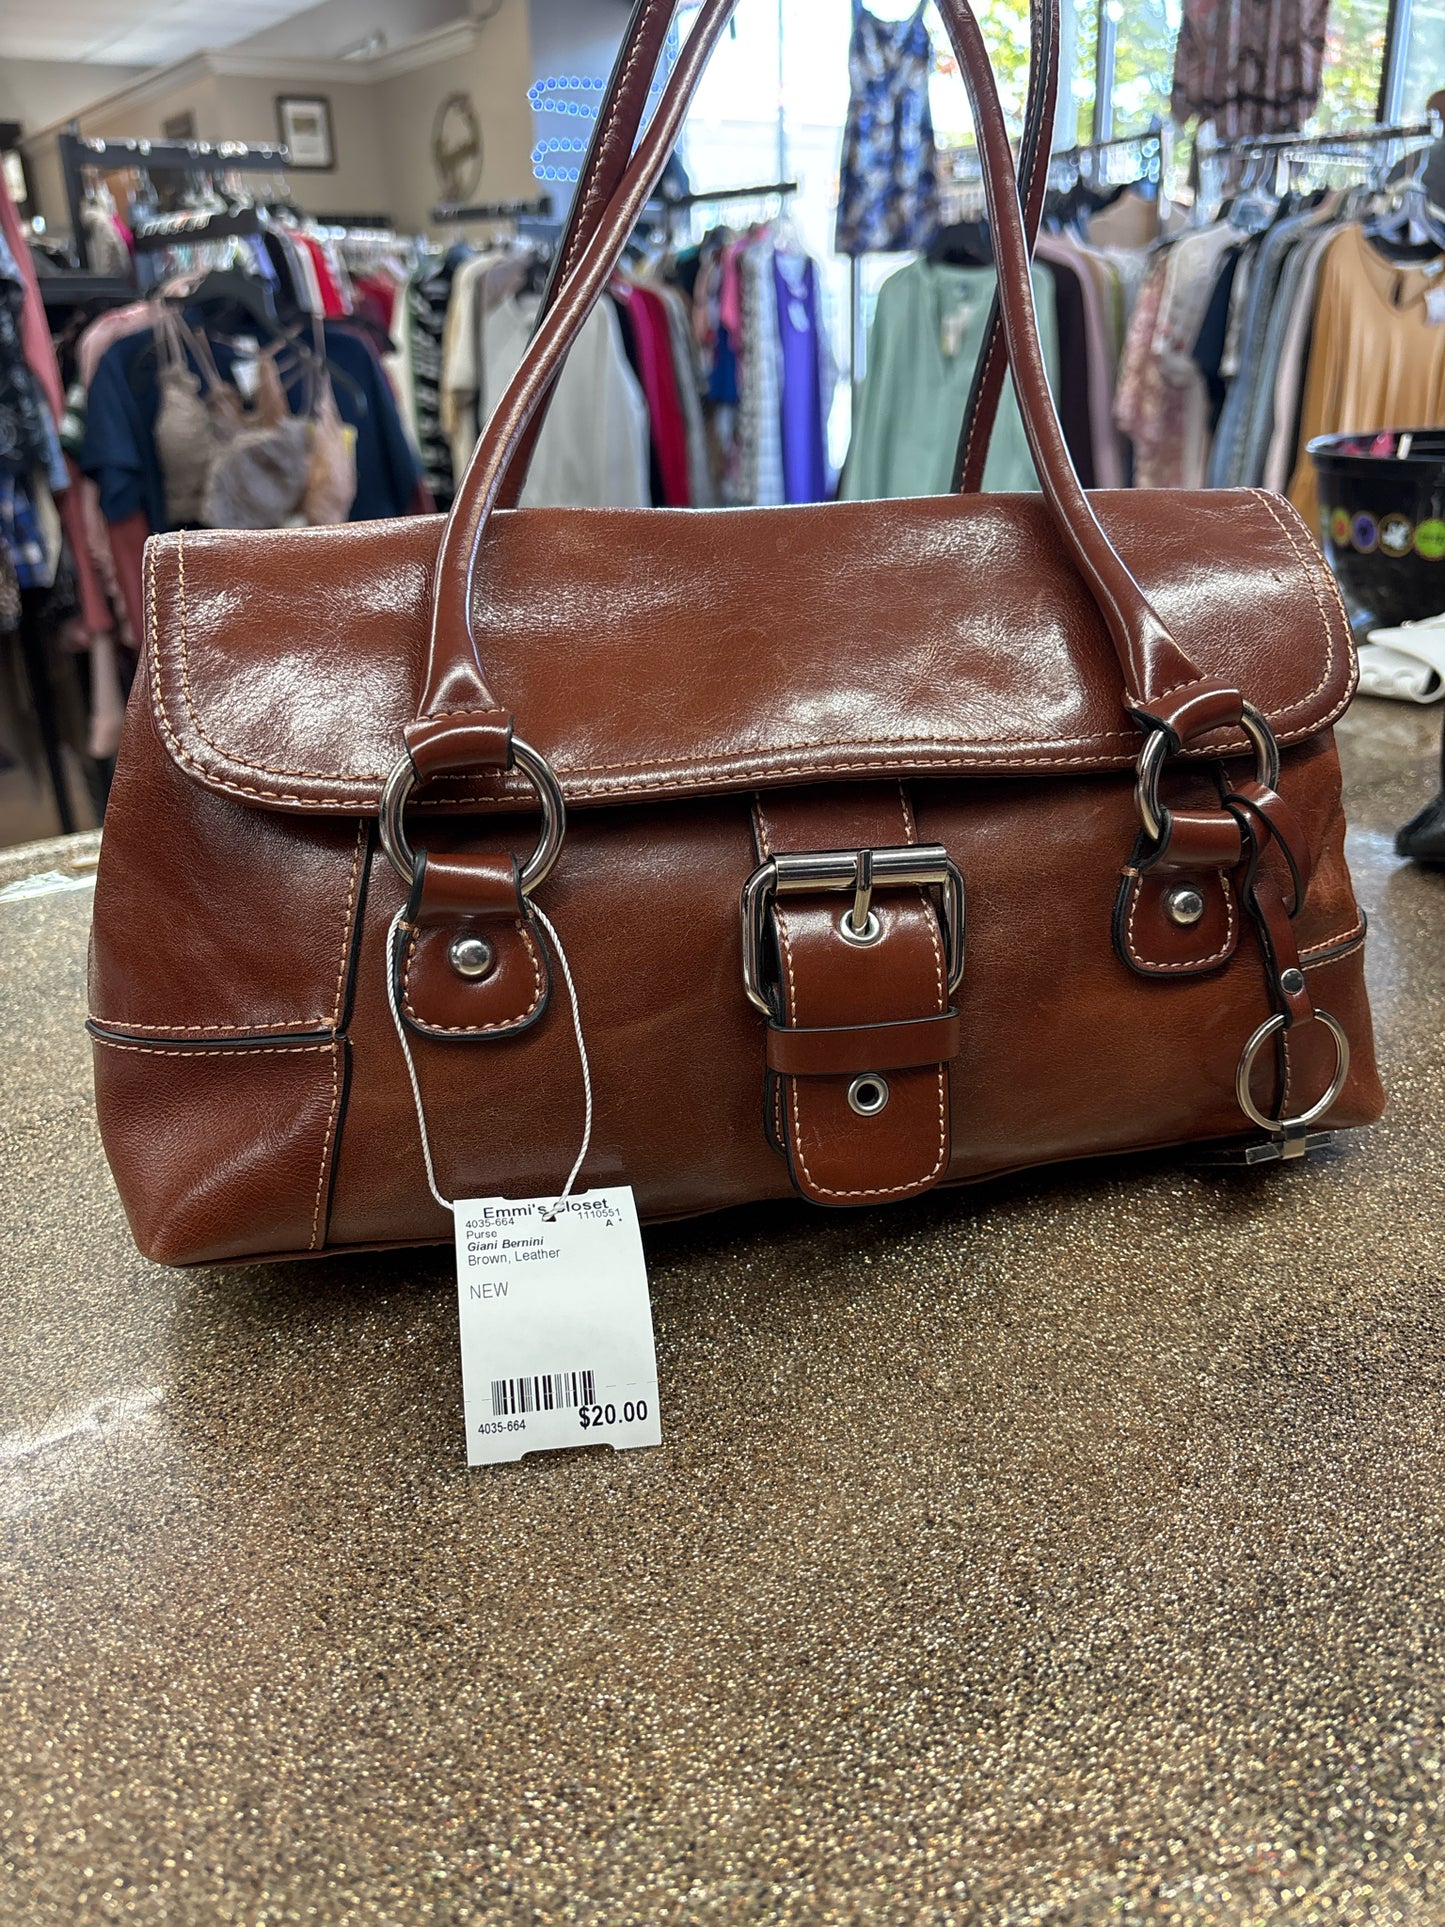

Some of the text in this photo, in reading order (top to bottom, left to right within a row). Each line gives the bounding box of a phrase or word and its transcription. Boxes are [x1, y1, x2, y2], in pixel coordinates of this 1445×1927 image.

[483, 1203, 546, 1219] Emmi's
[578, 1208, 621, 1219] 1110551
[465, 1217, 515, 1228] 4035-664
[605, 1219, 614, 1227] A
[466, 1230, 497, 1239] Purse
[467, 1236, 544, 1252] Giani Bernini
[468, 1248, 561, 1267] Brown, Leather
[469, 1281, 509, 1300] NEW
[578, 1400, 648, 1430] $20.00
[478, 1419, 527, 1435] 4035-664
